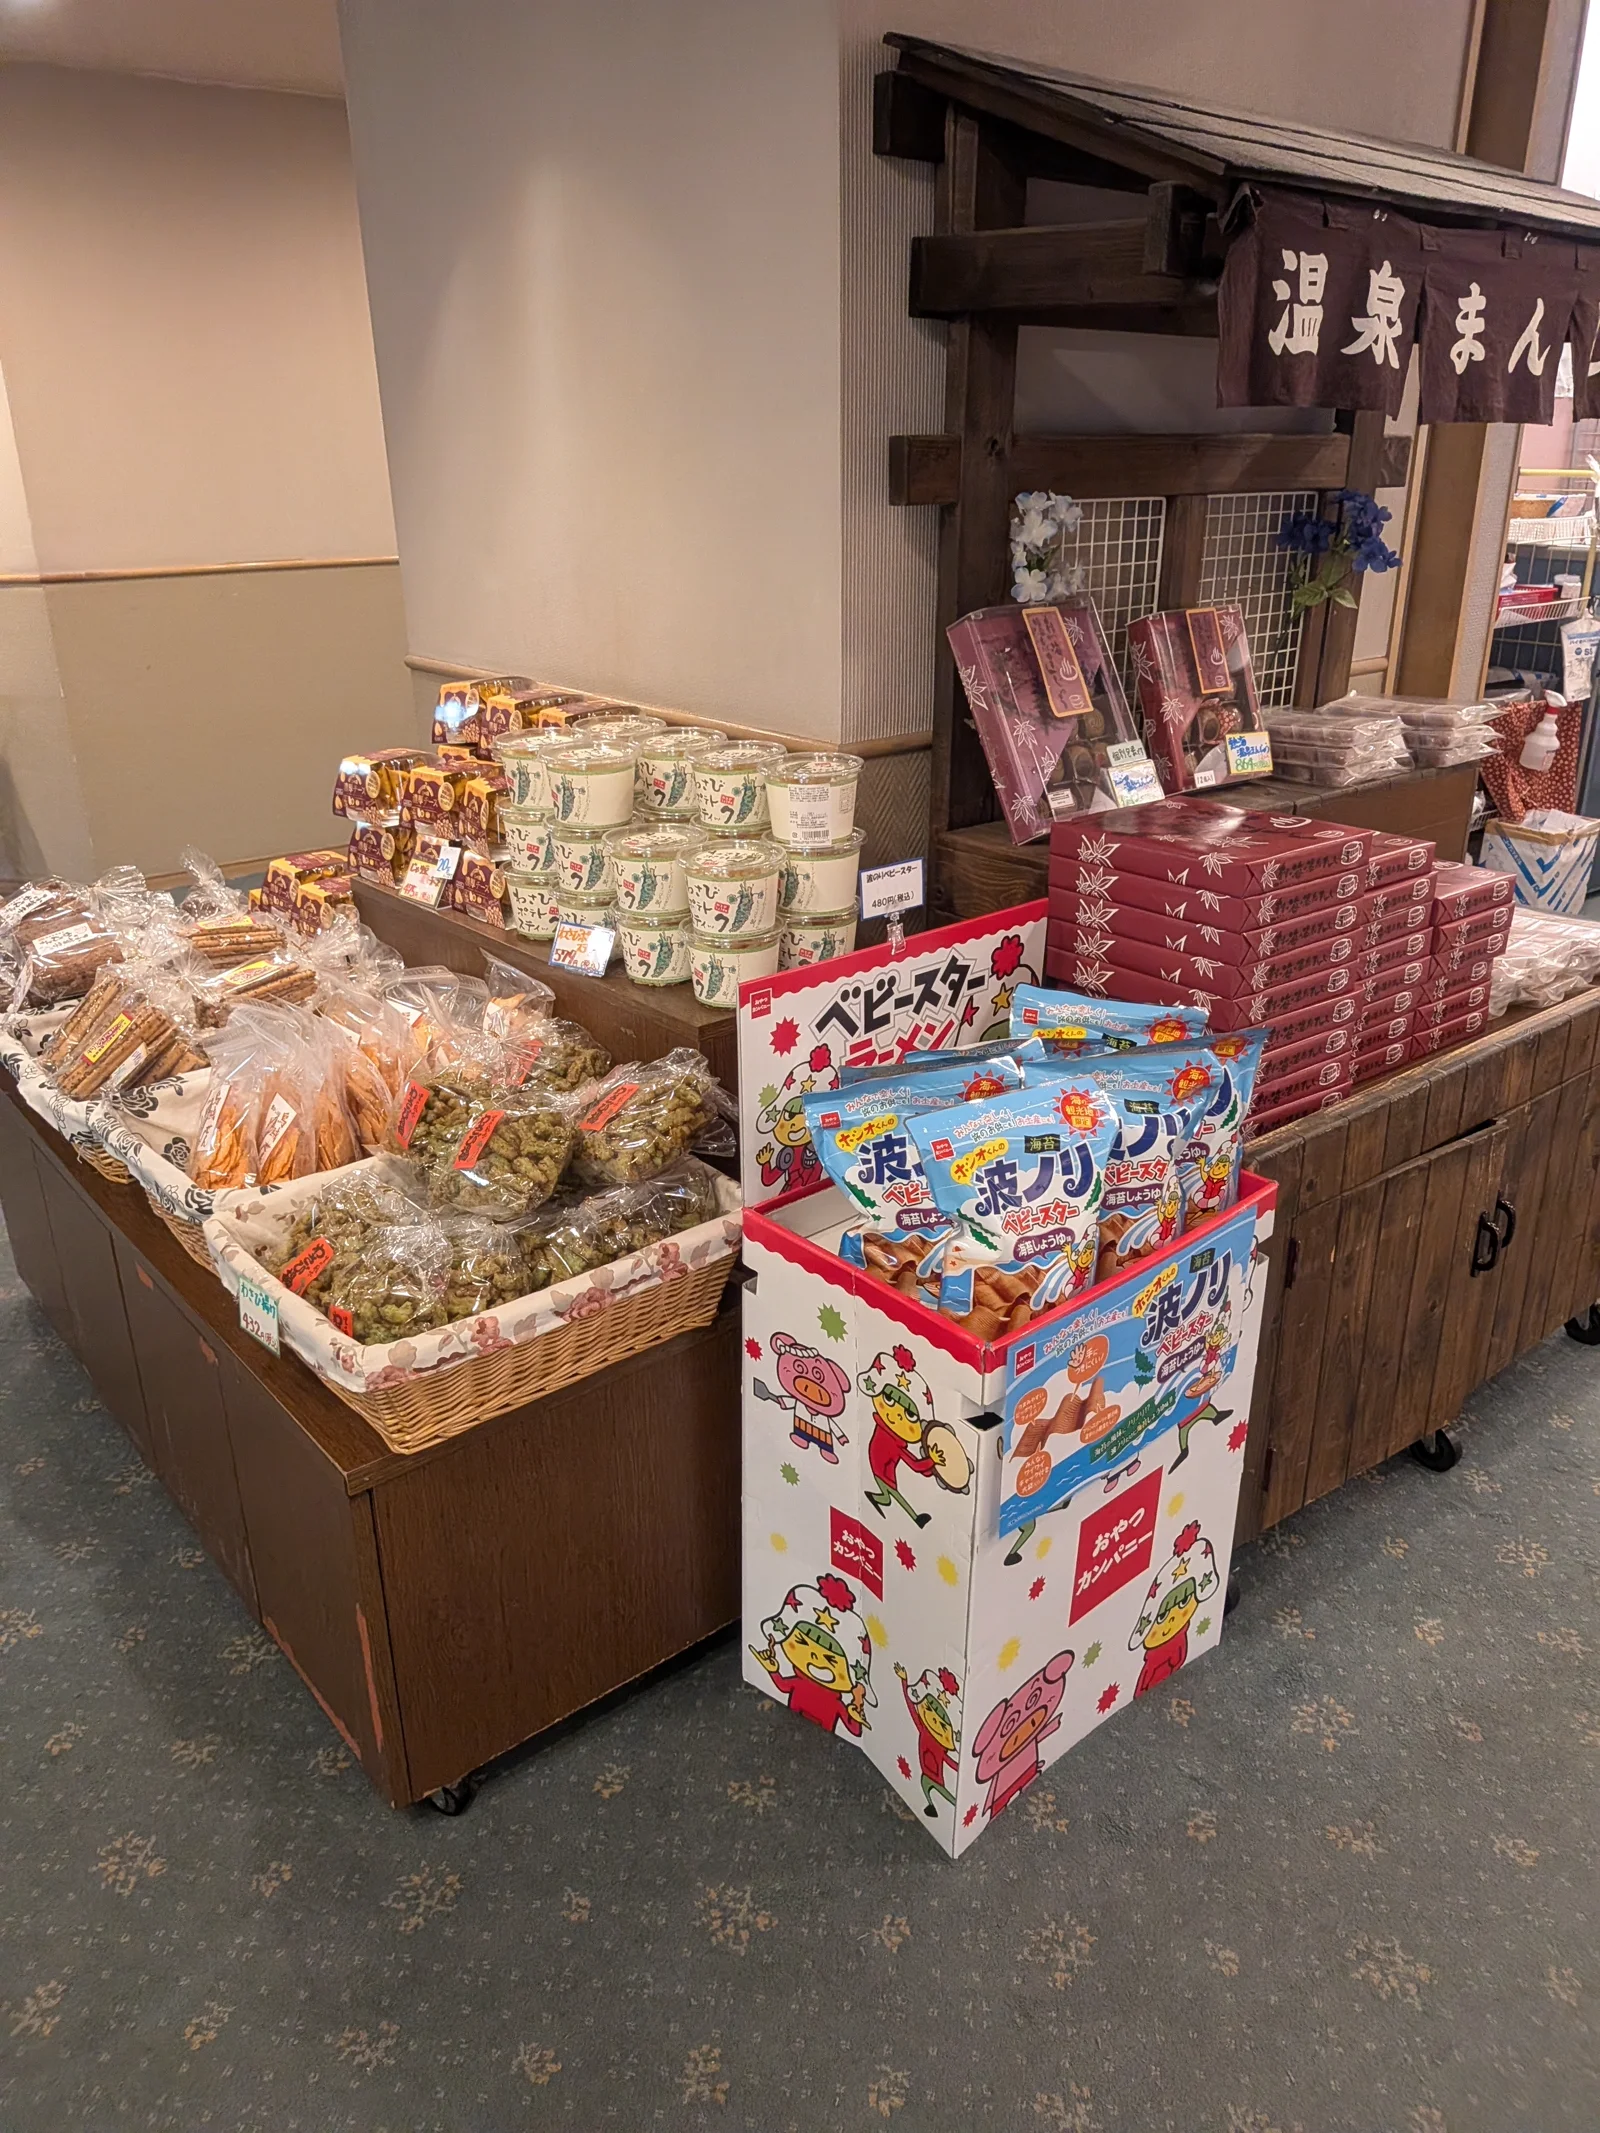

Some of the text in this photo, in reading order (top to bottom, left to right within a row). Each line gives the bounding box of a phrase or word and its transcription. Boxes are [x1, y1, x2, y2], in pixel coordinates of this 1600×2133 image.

[1268, 249, 1600, 377] 温泉まん
[866, 866, 918, 883] 波のりベビースター
[872, 891, 914, 908] 480円(税込)
[815, 954, 990, 1038] ベビースター
[838, 1117, 895, 1147] ホシオくんの
[1030, 1136, 1056, 1151] 海苔
[953, 1142, 1007, 1180] ホシオくんの
[974, 1142, 1095, 1217] 波ノリ
[1002, 1199, 1080, 1236] ベビースター
[1194, 1250, 1211, 1269] 海苔
[1134, 1266, 1177, 1315] ホシオくんの
[1142, 1249, 1232, 1347] 波ノリ
[1158, 1311, 1213, 1357] ベビースター
[842, 1529, 875, 1559] おやつ
[1091, 1507, 1145, 1557] おやつ
[833, 1540, 883, 1581] カンパニー
[1077, 1531, 1153, 1595] カンパニー
